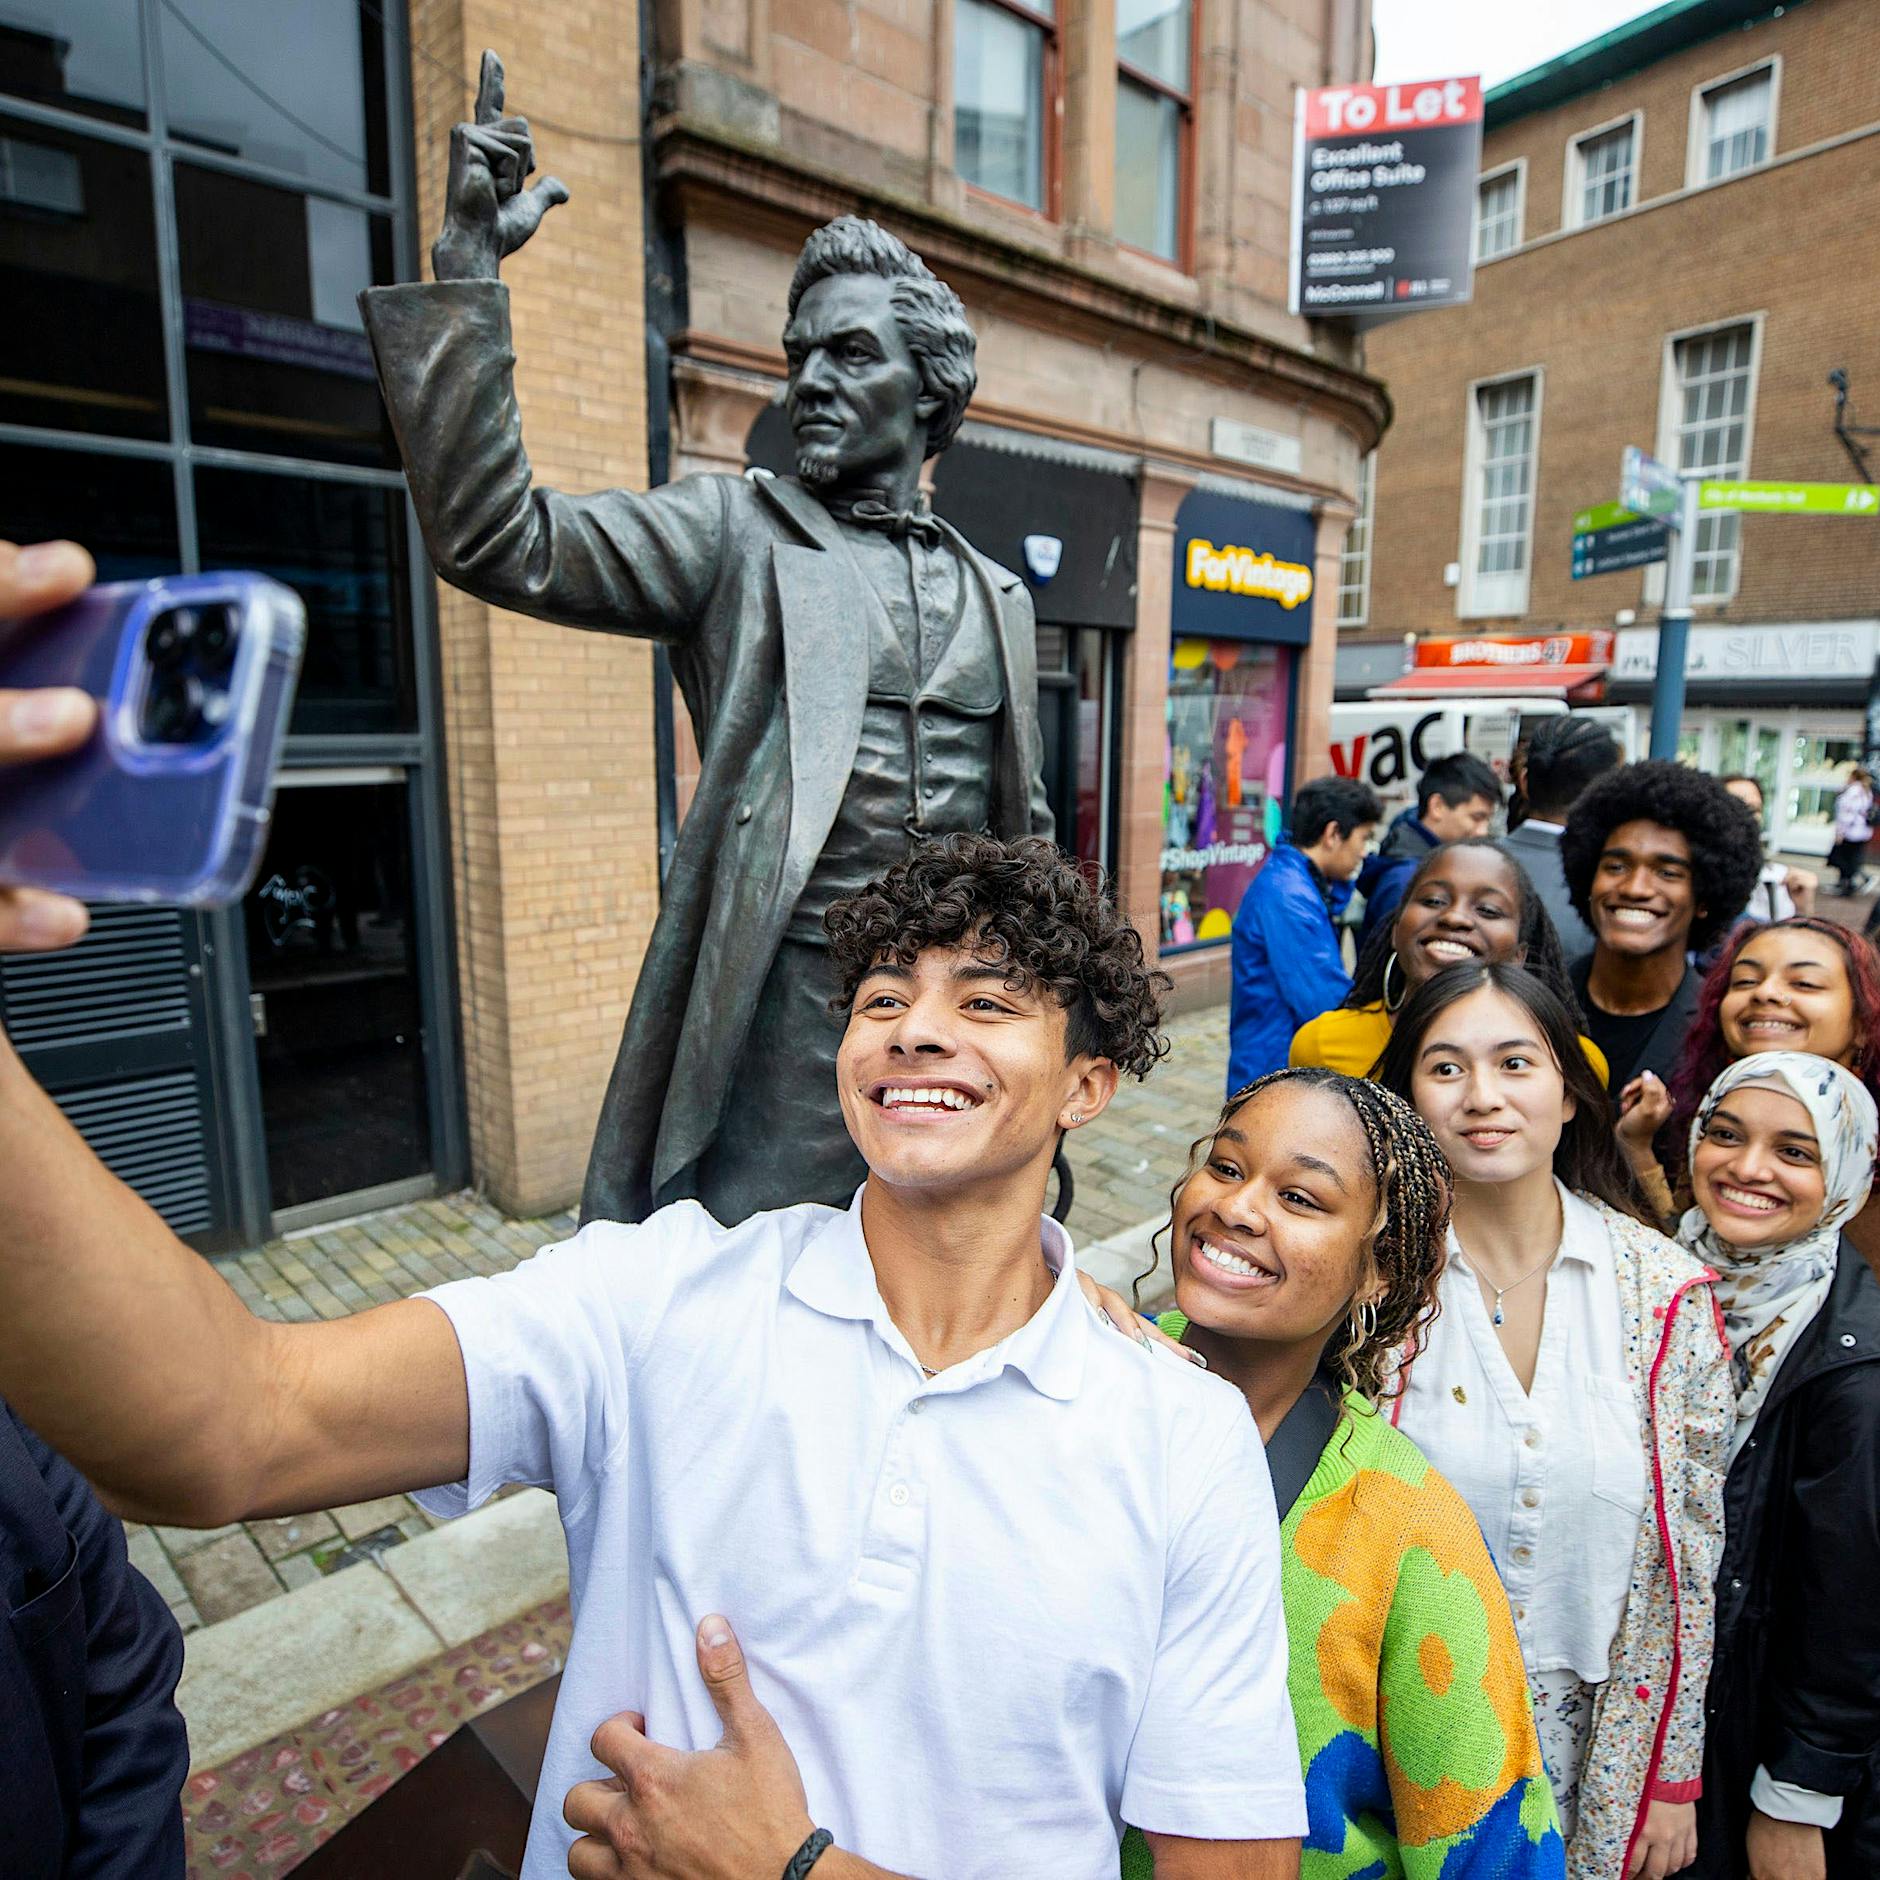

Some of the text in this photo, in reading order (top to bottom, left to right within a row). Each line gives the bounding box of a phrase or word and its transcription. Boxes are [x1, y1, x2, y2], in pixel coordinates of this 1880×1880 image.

[1319, 79, 1465, 129] To Let
[1311, 141, 1404, 169] Excellent
[1310, 163, 1426, 192] Office Suite
[1188, 543, 1311, 606] ForVintage
[1723, 631, 1858, 674] SILVER
